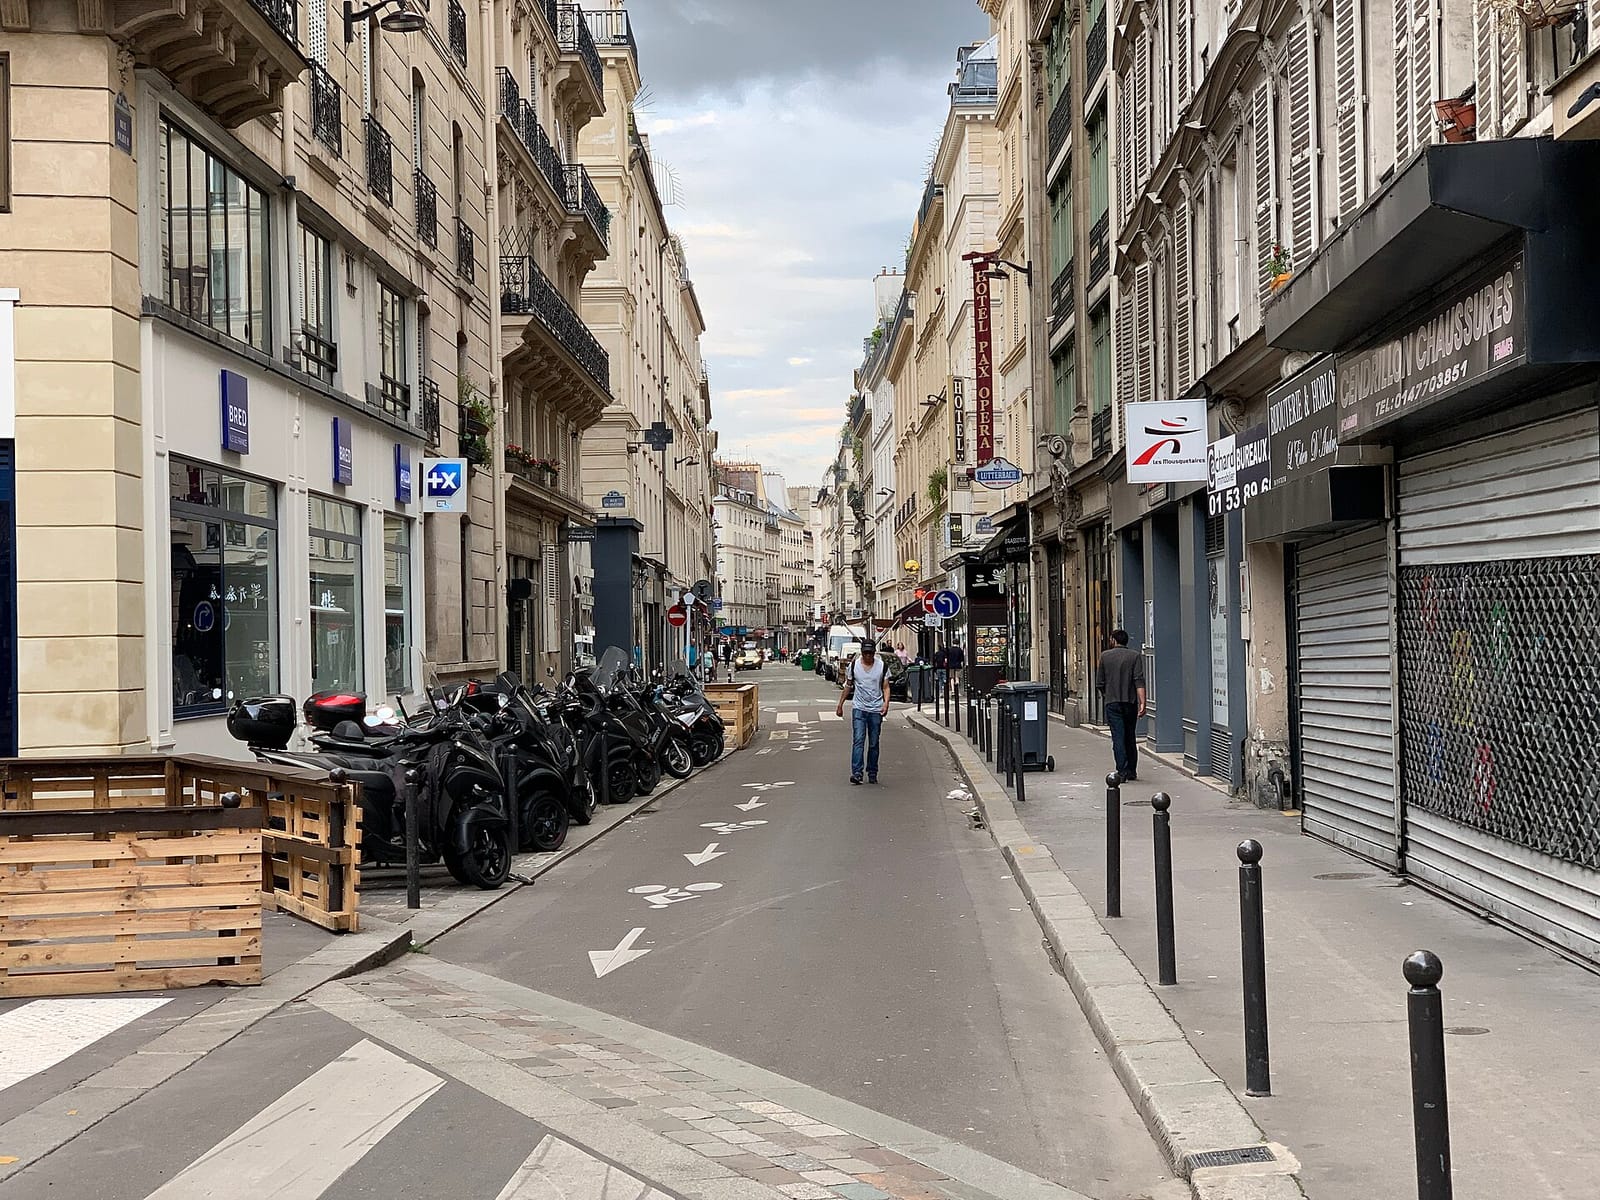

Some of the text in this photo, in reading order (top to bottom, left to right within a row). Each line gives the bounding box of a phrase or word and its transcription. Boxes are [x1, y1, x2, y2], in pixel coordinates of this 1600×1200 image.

[975, 270, 992, 449] HOTEL PAX OPERA
[1339, 271, 1514, 409] CENDRILLON CHAUSSURES
[1303, 384, 1310, 417] &
[1311, 369, 1336, 414] HORLO
[229, 404, 248, 427] BRED
[953, 382, 965, 450] HOTEL
[1236, 437, 1268, 472] BUREAUX
[980, 471, 1017, 480] LUTTERBACH
[1209, 492, 1222, 516] 01
[1226, 487, 1240, 511] 53
